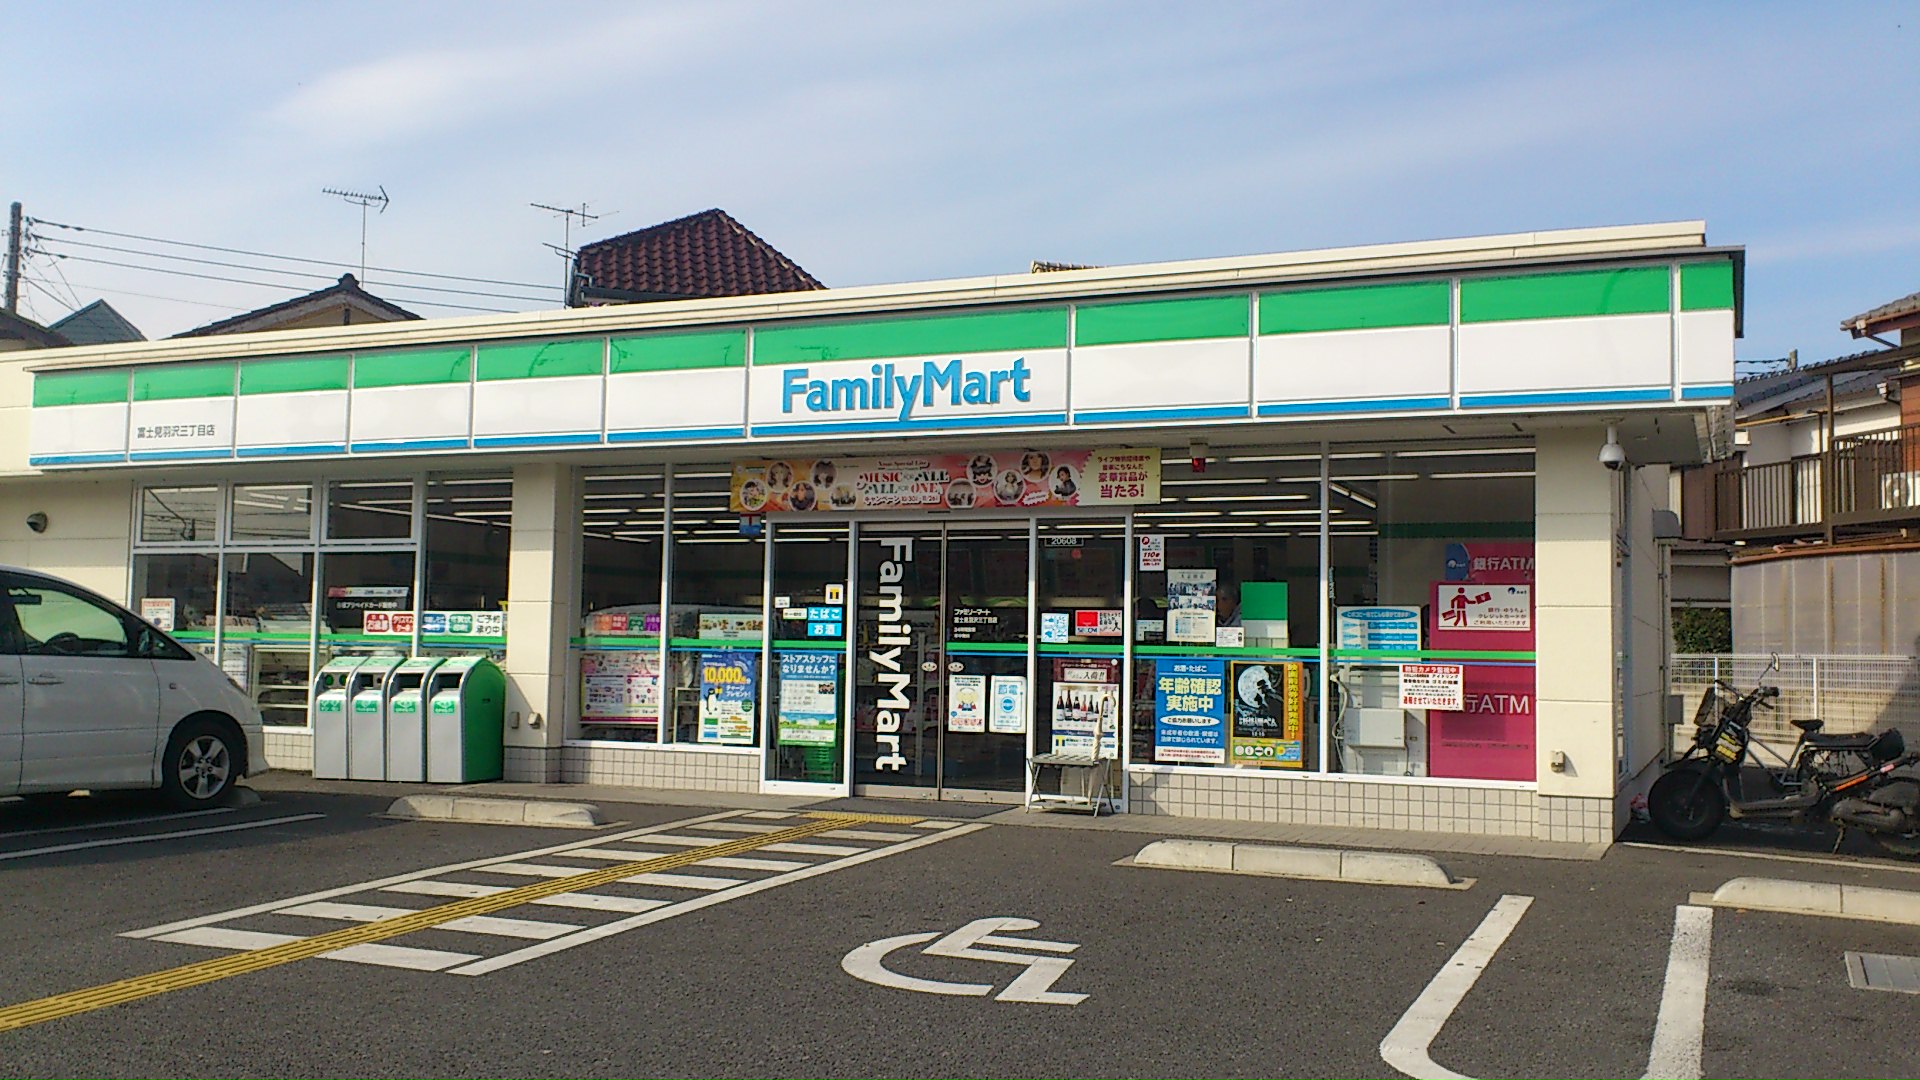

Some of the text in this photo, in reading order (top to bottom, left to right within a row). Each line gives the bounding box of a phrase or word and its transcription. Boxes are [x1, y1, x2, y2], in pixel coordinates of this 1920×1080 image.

[782, 357, 1031, 421] FamilyMart
[137, 424, 215, 439] 富士見羽沢三丁目店
[861, 471, 903, 483] MUSIC
[1098, 471, 1148, 483] 豪華賞品が
[809, 608, 840, 619] たばこ
[953, 608, 992, 616] ファミリーマート
[814, 624, 835, 635] お酒
[782, 654, 835, 663] ストアスタッフに
[869, 537, 913, 772] FamilyMart
[1158, 677, 1222, 695] 年齢確認
[1166, 695, 1214, 713] 実施中
